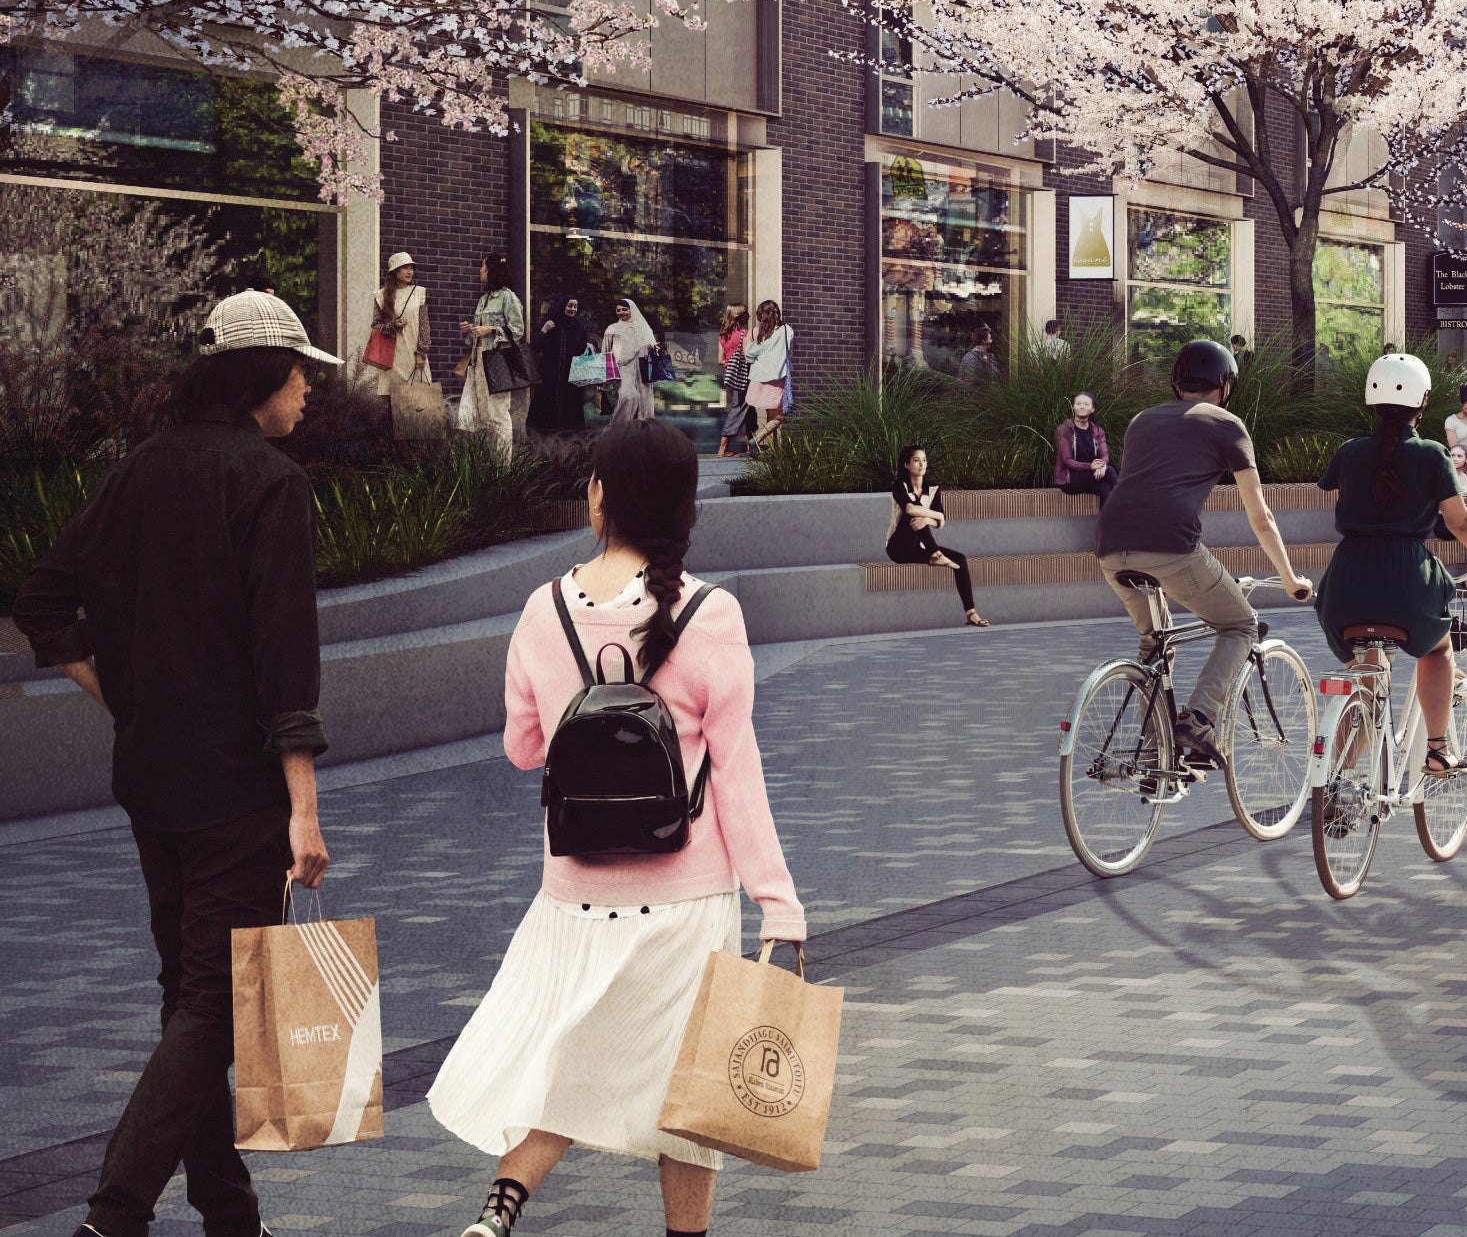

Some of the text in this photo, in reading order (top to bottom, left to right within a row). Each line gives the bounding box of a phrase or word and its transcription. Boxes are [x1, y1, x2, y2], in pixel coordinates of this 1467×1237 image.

[1436, 270, 1449, 278] The
[1440, 282, 1465, 290] Lobster
[1440, 320, 1467, 328] BISTRO
[290, 1023, 341, 1046] HEMTEX
[740, 1093, 787, 1115] EST 1912
